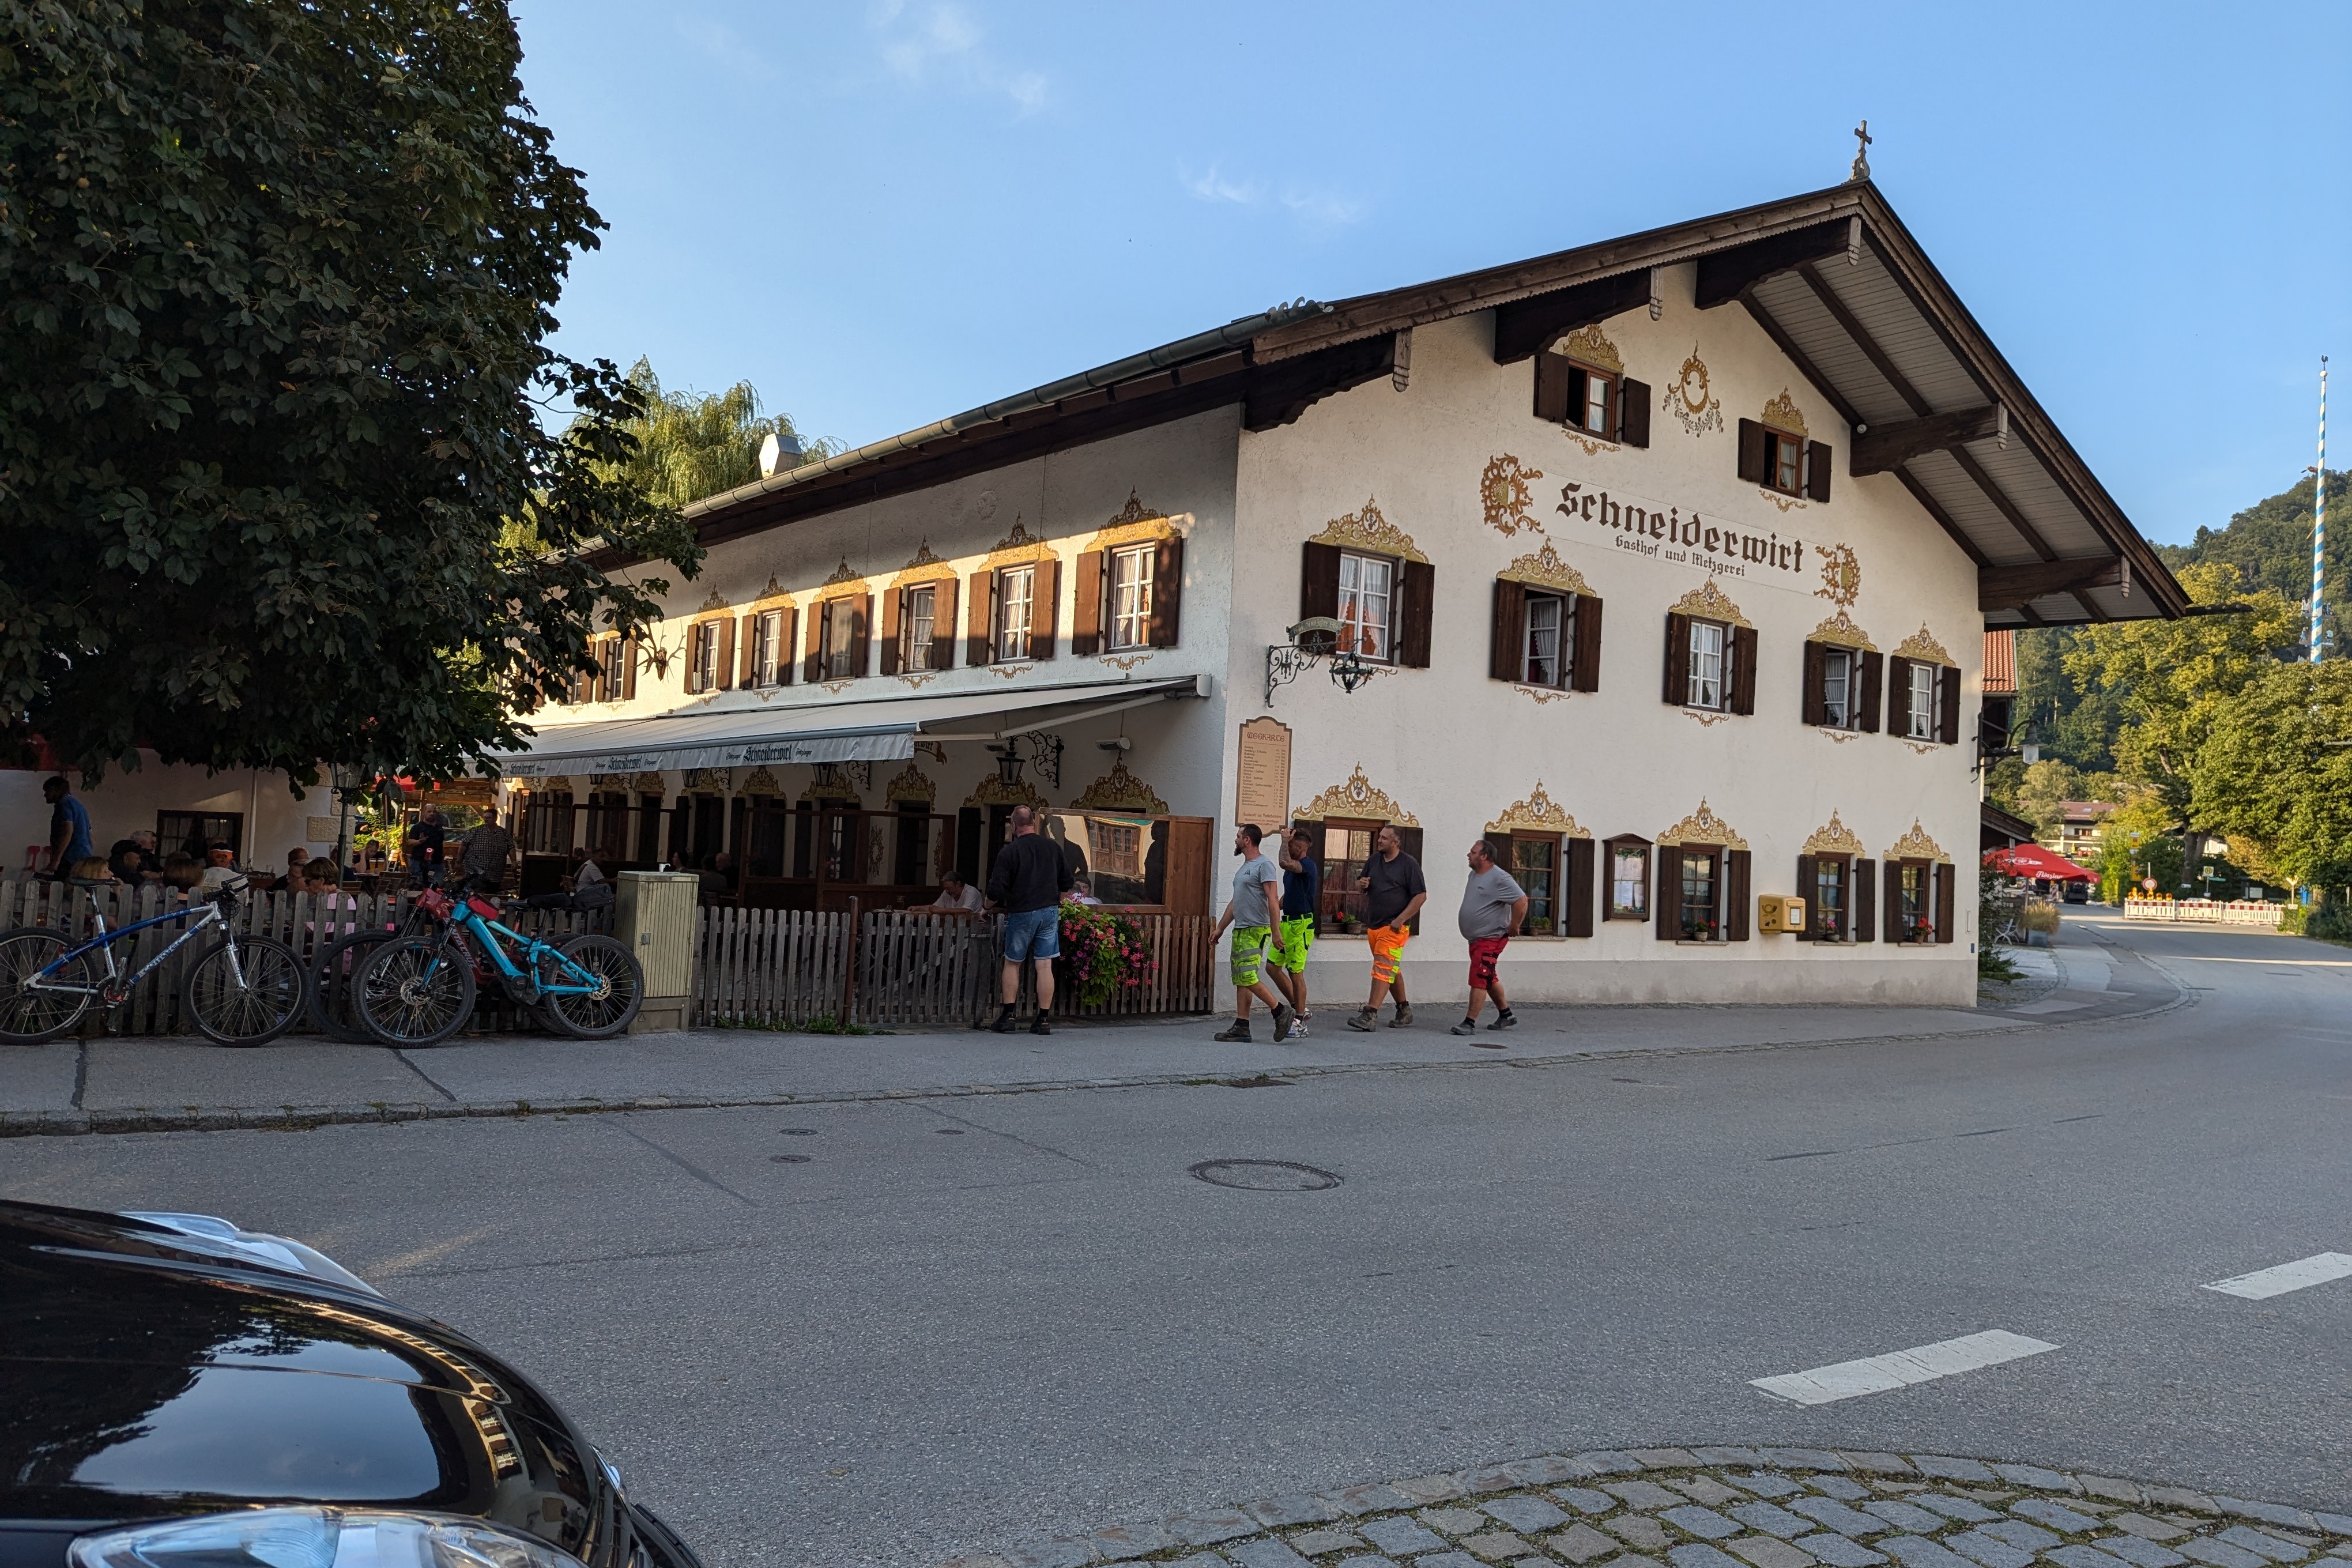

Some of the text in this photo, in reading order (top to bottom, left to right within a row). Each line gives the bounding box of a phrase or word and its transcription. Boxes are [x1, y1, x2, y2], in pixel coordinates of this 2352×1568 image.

[1555, 482, 1804, 574] Schneiderwirt
[1615, 535, 1746, 576] Gasthof und Metzgerei
